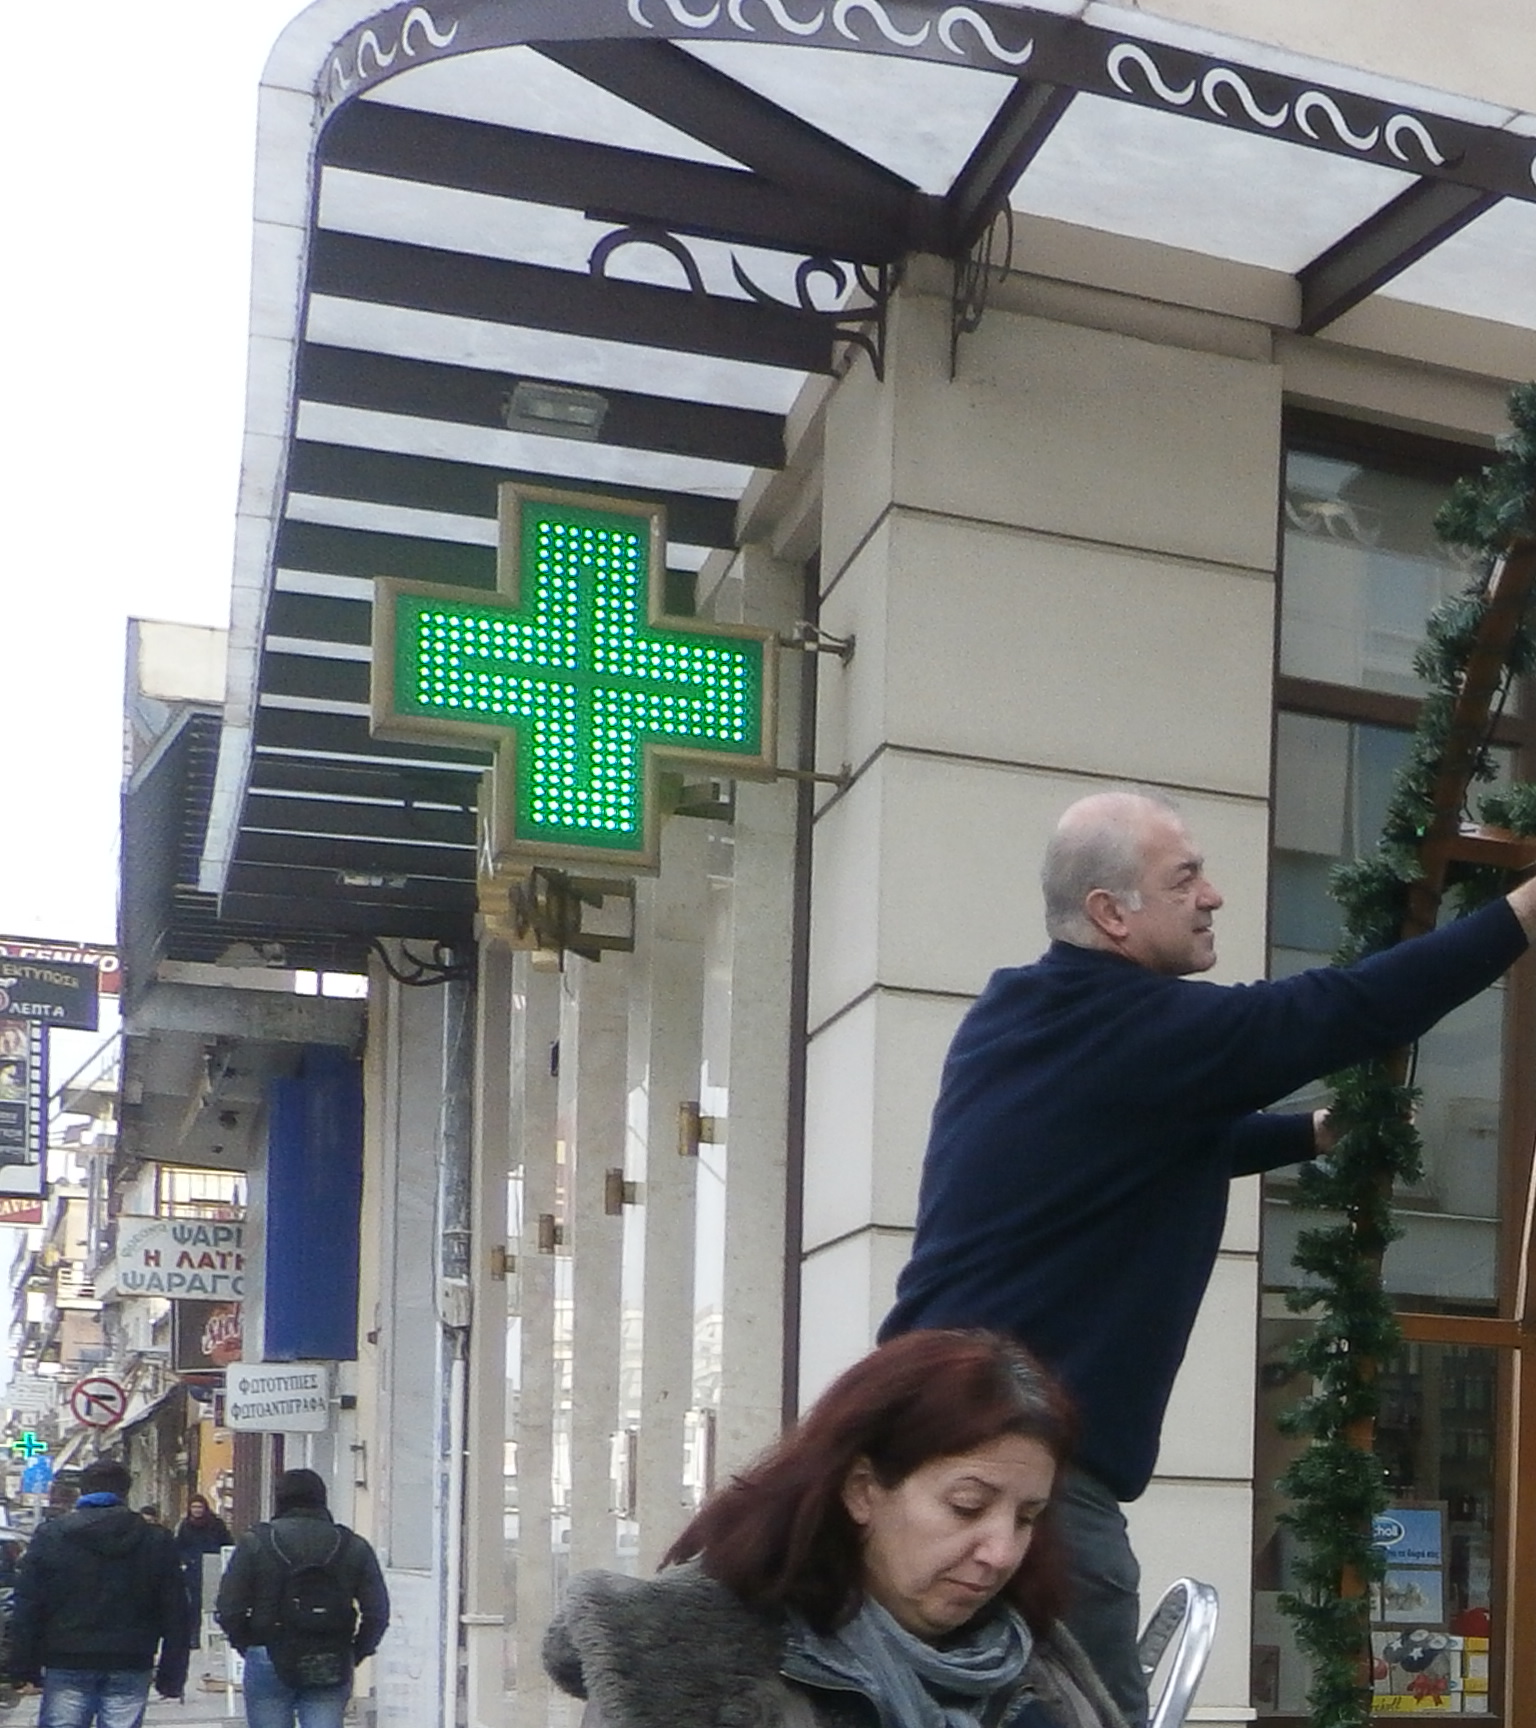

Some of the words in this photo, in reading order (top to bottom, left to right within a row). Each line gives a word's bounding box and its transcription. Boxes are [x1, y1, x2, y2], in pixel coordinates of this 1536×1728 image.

[143, 1249, 161, 1267] Η
[238, 1374, 319, 1395] ΦΩΤΟΤΥΠΙΕΣ
[230, 1397, 326, 1421] ΦΩΤΟΑΝΤΙΓΡΑΦΑ
